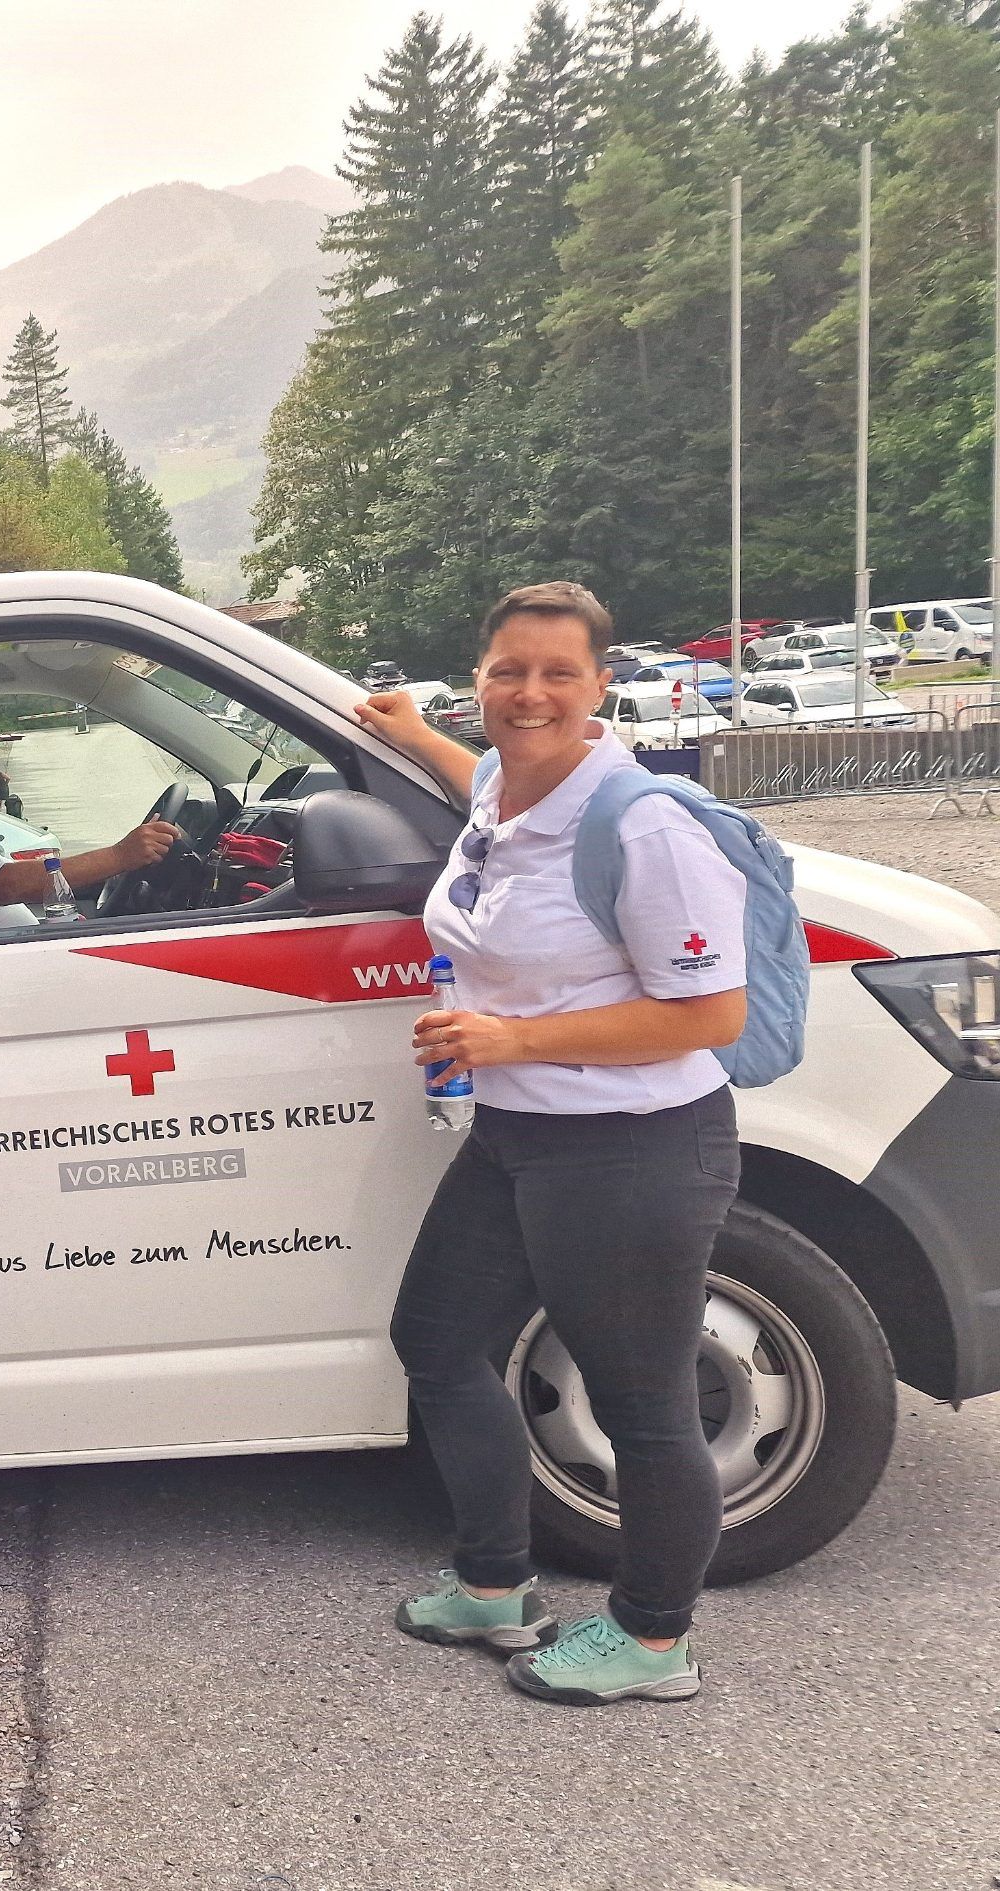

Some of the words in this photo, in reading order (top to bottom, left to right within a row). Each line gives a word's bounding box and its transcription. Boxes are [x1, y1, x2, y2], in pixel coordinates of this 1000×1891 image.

[190, 1110, 274, 1136] ROTES
[286, 1101, 375, 1128] KREUZ
[66, 1154, 239, 1186] VORARLBERG
[45, 1243, 115, 1270] Liebe
[130, 1247, 188, 1264] zum
[206, 1228, 351, 1258] Menschen.
